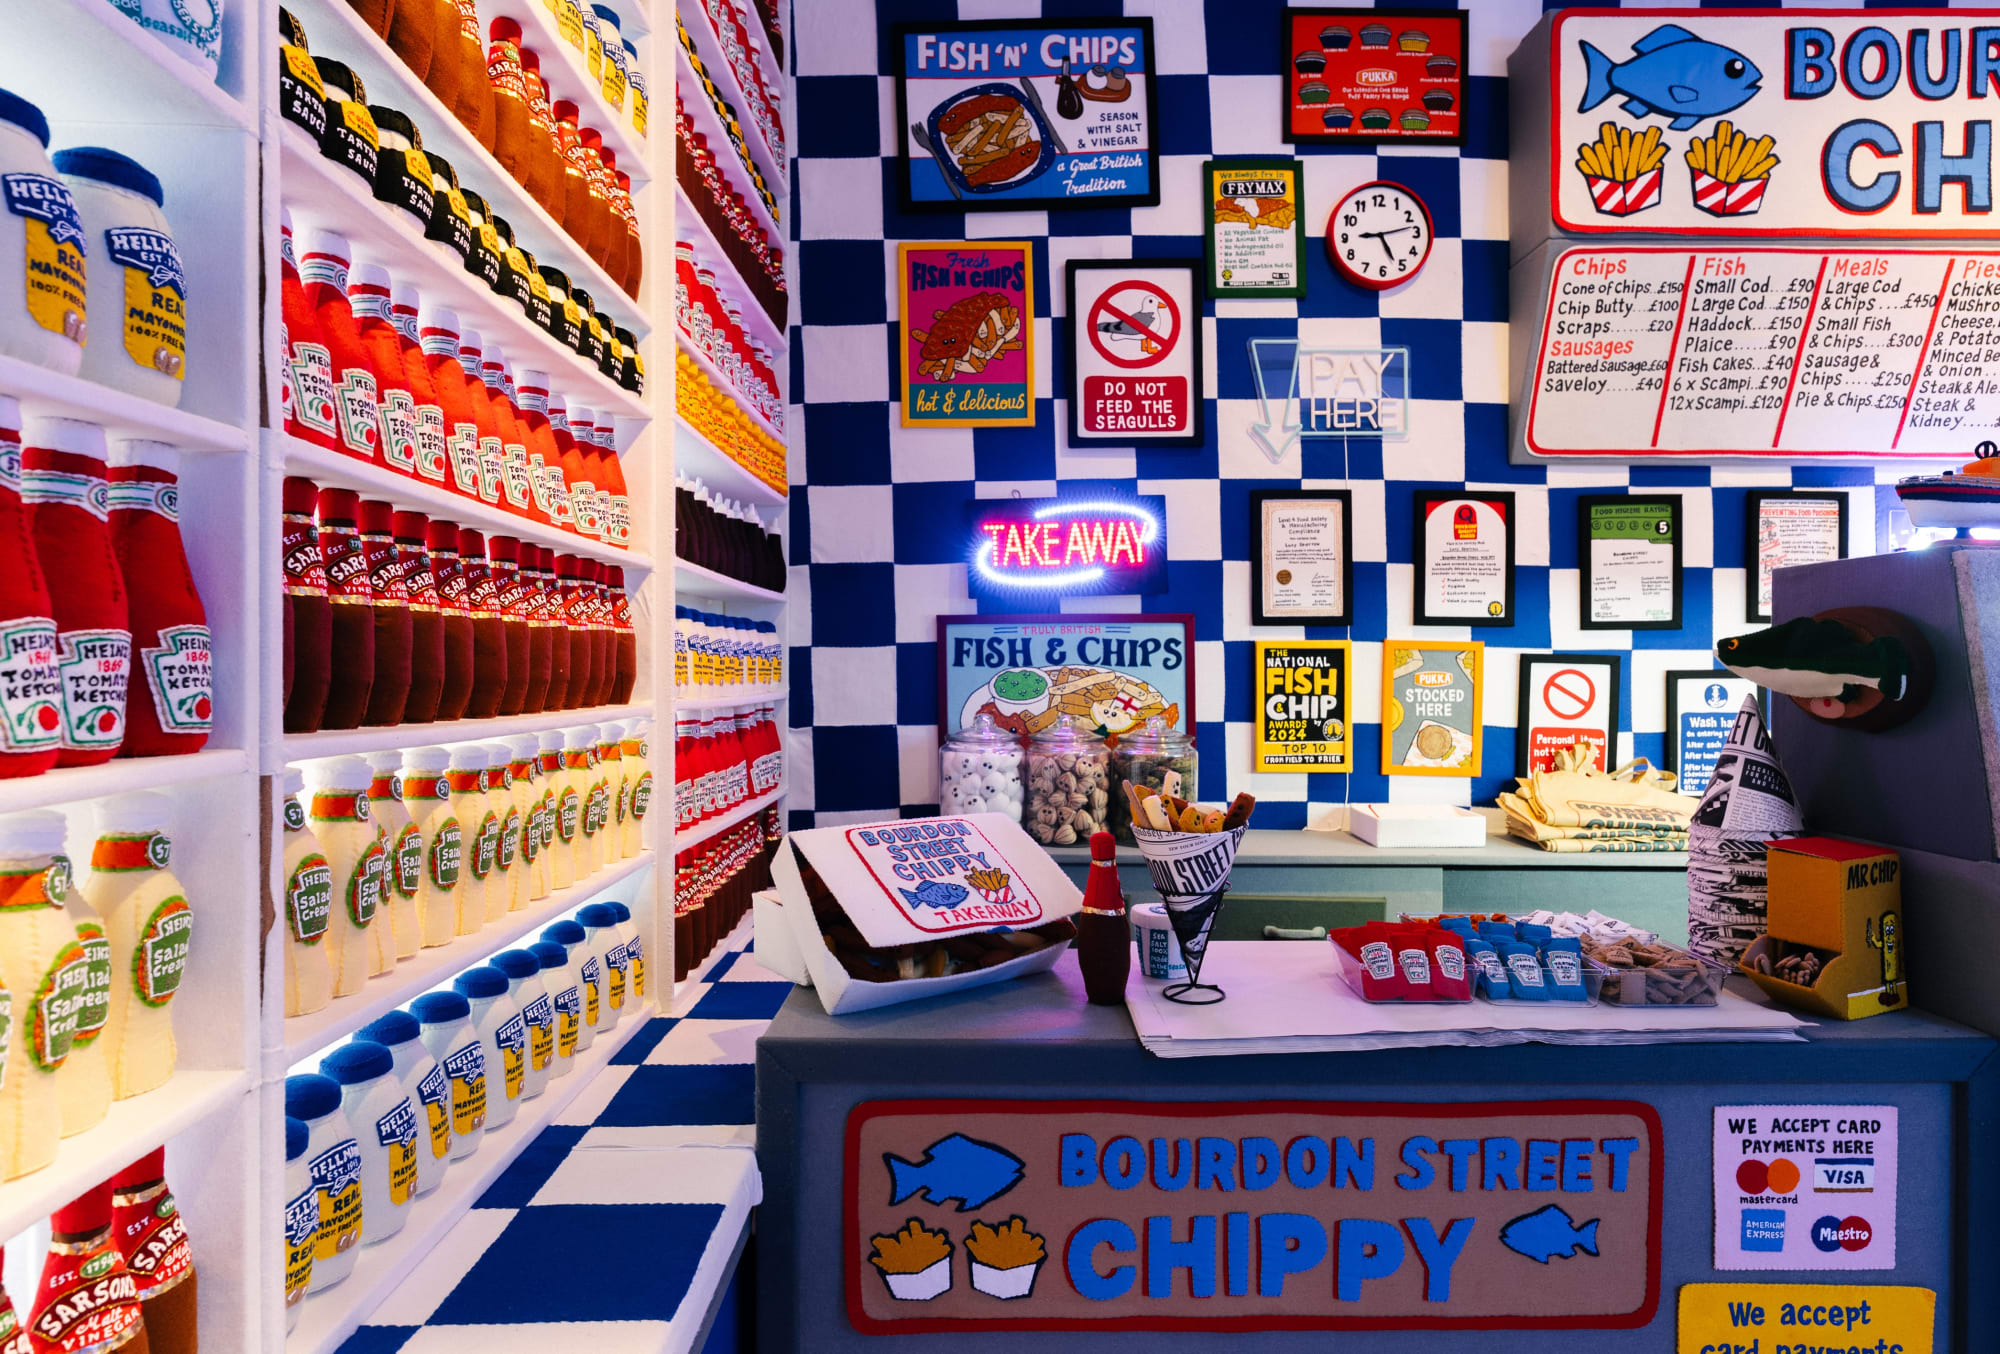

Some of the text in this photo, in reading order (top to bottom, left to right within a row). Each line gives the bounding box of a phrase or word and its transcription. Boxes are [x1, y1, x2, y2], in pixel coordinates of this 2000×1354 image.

[917, 35, 990, 72] FISH
[1040, 34, 1136, 66] CHIPS
[1362, 71, 1394, 82] PUKKA
[1100, 112, 1138, 122] SEASON
[1086, 123, 1143, 136] WITH SALT
[1077, 136, 1138, 148] & VINEGAR
[1070, 153, 1143, 179] Great British
[1820, 117, 1994, 216] CH
[1063, 178, 1127, 195] Tradition
[1227, 182, 1285, 195] FRYMAX
[1355, 201, 1367, 213] 11
[1372, 195, 1386, 207] 12
[1393, 198, 1400, 210] 1
[1344, 215, 1358, 226] 10
[1404, 211, 1414, 223] 2
[1341, 233, 1349, 244] 9
[1412, 226, 1421, 238] 3
[1346, 249, 1355, 261] 8
[1409, 245, 1418, 257] 4
[946, 252, 990, 269] Fresh
[1361, 262, 1370, 273] 7
[1398, 259, 1407, 271] 5
[1574, 257, 1627, 280] Chips
[1703, 256, 1745, 276] Fish
[1833, 258, 1889, 277] Meals
[912, 261, 1025, 292] FISH CHIPS
[1379, 265, 1387, 277] 6
[1563, 280, 1685, 298] Cone of Chips £150
[1694, 275, 1815, 294] Small Cod £90
[1826, 277, 1902, 298] Large Cod
[1558, 299, 1679, 319] Chip Butty £100
[1692, 295, 1809, 315] Large Cod £150
[1821, 293, 1938, 315] & Chips £450
[1557, 320, 1673, 339] Scraps £20
[1688, 315, 1802, 332] Haddock £150
[1816, 316, 1891, 331] Small Fish
[1685, 335, 1797, 353] Plaice £90
[1809, 333, 1923, 352] & Chips £300
[1547, 360, 1599, 374] Battered
[1679, 354, 1793, 373] Fish Cakes £40
[1310, 351, 1396, 397] PAY
[1801, 371, 1912, 390] Chips £250
[1104, 382, 1167, 396] DO NOT
[1545, 376, 1663, 395] Saveloy £40
[1673, 375, 1788, 393] 6 x Scampi £90
[917, 388, 939, 412] hot
[959, 387, 1025, 411] delicious
[1096, 399, 1173, 414] FEED THE
[1753, 395, 1783, 409] £120
[1795, 391, 1907, 413] Pie & Chips £250
[1095, 414, 1177, 429] SEAGULLS
[1311, 398, 1398, 431] HERE
[1658, 521, 1668, 534] 5
[1022, 625, 1102, 635] TRULY BRITISH
[952, 636, 1183, 670] FISH & CHIPS
[1270, 649, 1288, 658] THE
[1266, 656, 1330, 668] NATIONAL
[1266, 667, 1337, 696] FISH
[1418, 674, 1452, 687] PUKKA
[1405, 688, 1465, 703] STOCKED
[1266, 694, 1337, 720] CHIP
[1415, 702, 1452, 717] HERE
[1269, 719, 1307, 730] AWARDS
[1690, 717, 1718, 728] Wash
[1269, 729, 1307, 741] 2024
[1536, 734, 1575, 745] Personal
[1282, 743, 1326, 754] TOP 10
[290, 808, 302, 821] 57
[859, 821, 972, 846] BOURDON
[887, 836, 970, 861] STREET
[892, 851, 992, 882] CHIPPY
[1173, 839, 1230, 894] STREET
[1847, 859, 1898, 891] MR CHIP
[934, 899, 1034, 924] TAKEAWAY
[1728, 1118, 1882, 1135] WE ACCEPT CARD
[1742, 1139, 1874, 1155] PAYMENTS HERE
[1058, 1132, 1640, 1195] BOURDON STREET
[1823, 1168, 1865, 1185] VISA
[1739, 1194, 1798, 1205] mastercard
[1745, 1220, 1785, 1230] AMERICAN
[1746, 1229, 1785, 1239] EXPRESS
[1819, 1226, 1870, 1242] Maestro
[1065, 1211, 1476, 1302] CHIPPY
[49, 1270, 78, 1289] EST.
[1728, 1299, 1872, 1332] We accept
[61, 1308, 140, 1350] VINEGAR
